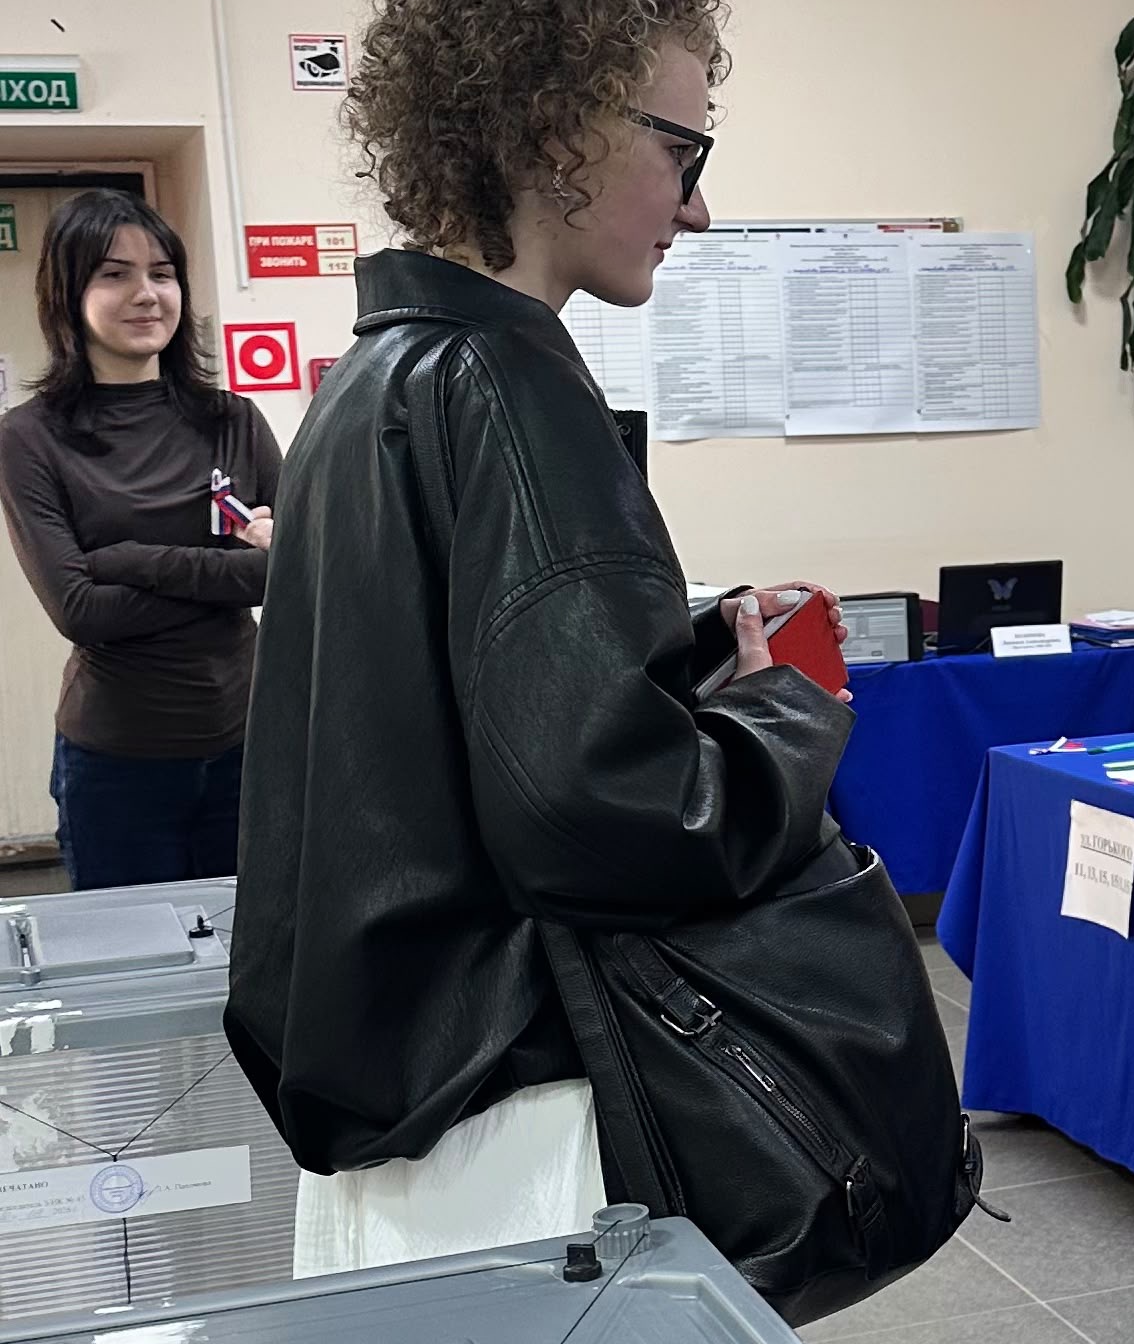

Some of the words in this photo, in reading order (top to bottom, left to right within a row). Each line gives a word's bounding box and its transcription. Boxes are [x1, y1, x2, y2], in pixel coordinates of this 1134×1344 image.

[249, 235, 270, 247] ПРИ
[271, 235, 315, 247] ПОЖАРЕ
[260, 256, 308, 268] ЗВОНИТЬ
